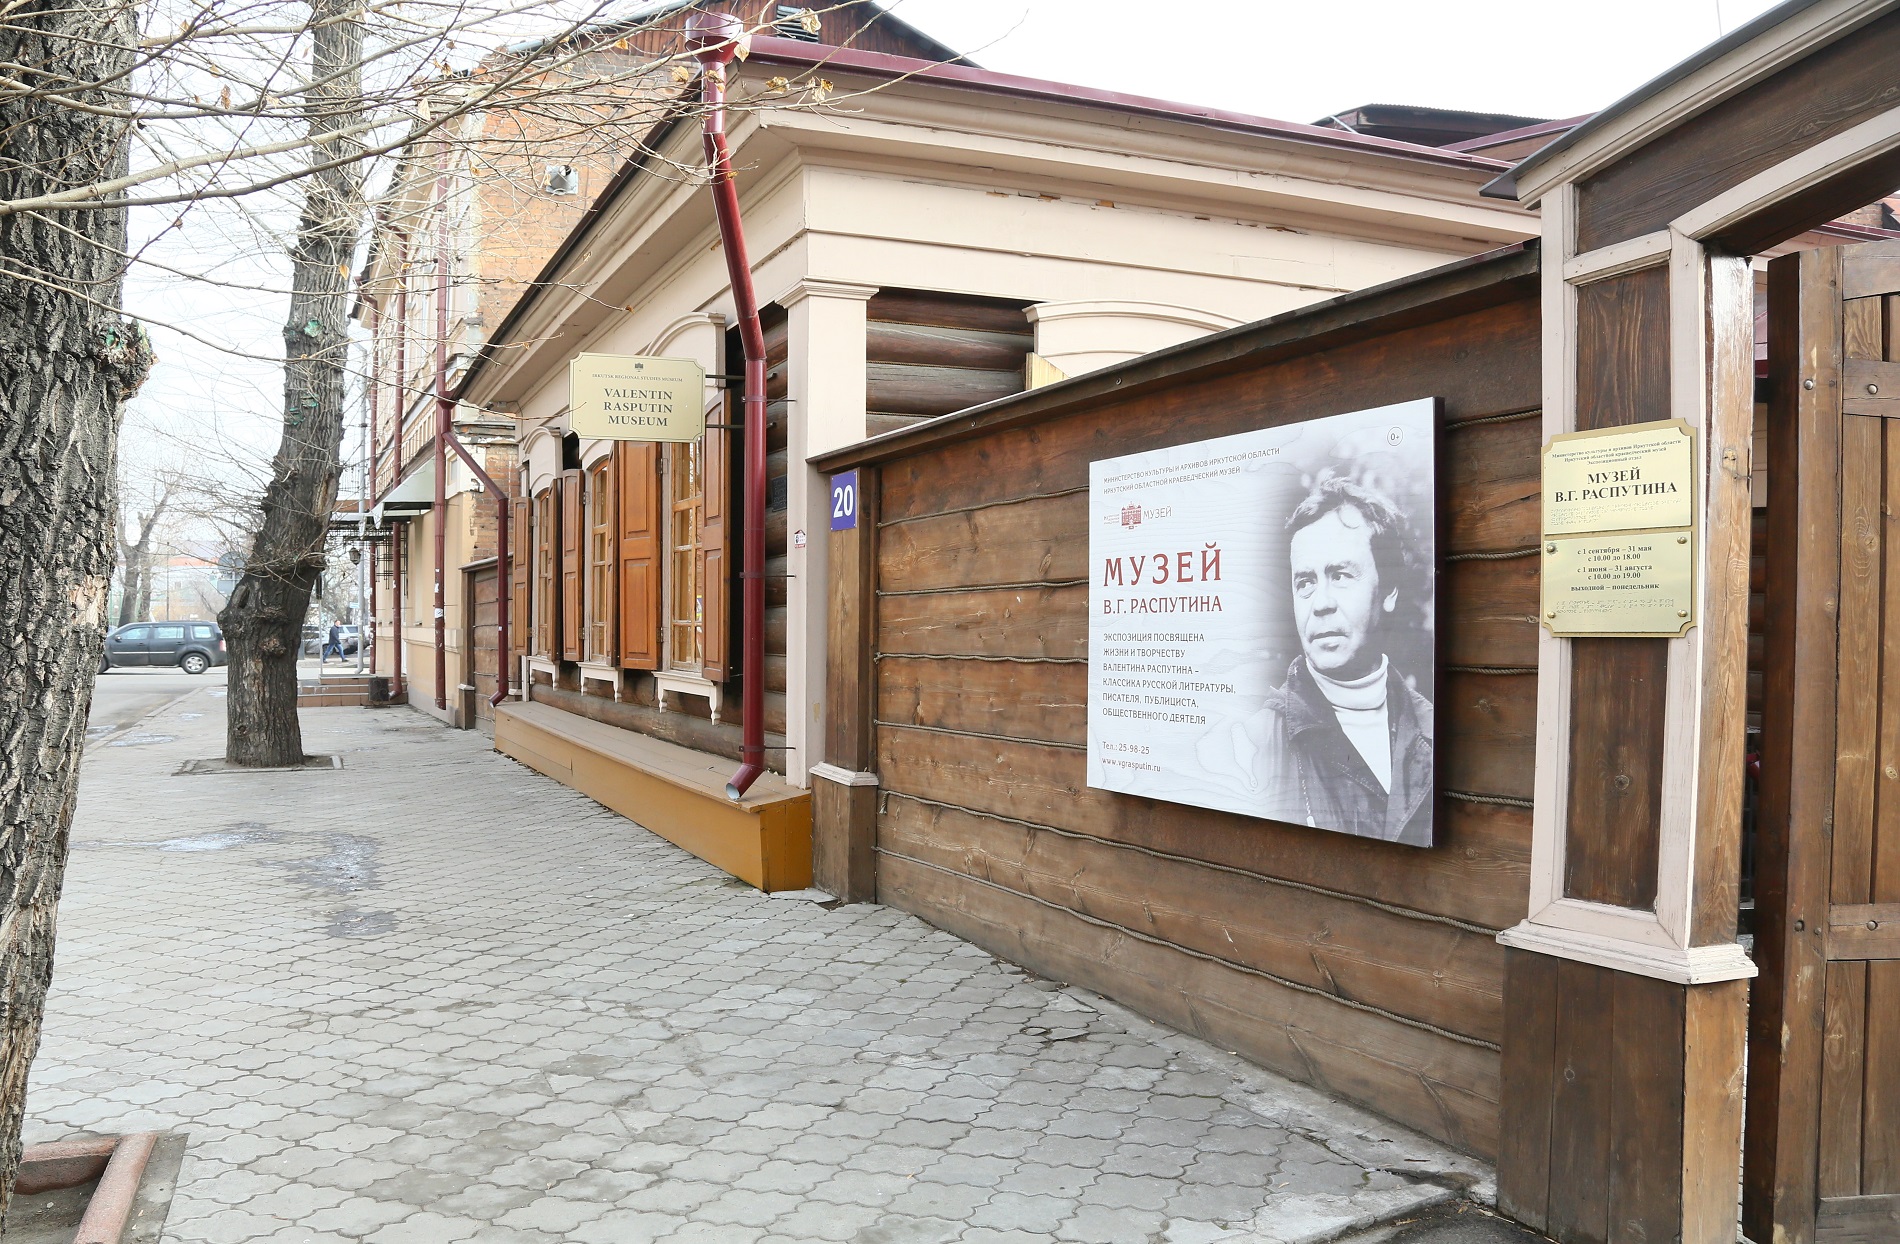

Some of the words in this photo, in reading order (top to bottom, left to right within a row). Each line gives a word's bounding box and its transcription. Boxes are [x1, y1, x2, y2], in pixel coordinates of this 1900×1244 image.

[604, 388, 673, 400] VALENTIN
[603, 401, 673, 413] RASPUTIN
[608, 415, 668, 426] MUSEUM
[1104, 472, 1144, 484] МИНИСТЕРСТВО
[1145, 466, 1174, 477] КУЛЬТУРЫ
[1180, 460, 1208, 471] АРХИВОВ
[1209, 452, 1246, 466] ИРКУТСКОЙ
[1247, 447, 1280, 459] ОБЛАСТИ
[1104, 483, 1134, 495] ИРКУТСКИЙ
[1134, 478, 1168, 490] ОБЛАСТНОЙ
[1169, 469, 1218, 484] КРАЕВЕДЧЕСКИЙ
[1220, 466, 1241, 477] МУЗЕЙ
[1587, 466, 1641, 484] МУЗЕЙ
[1555, 491, 1578, 502] В.Г.
[1582, 482, 1677, 500] РАСПУТИНА
[833, 484, 854, 518] 20
[1143, 505, 1172, 520] МУЗЕЙ
[1588, 547, 1620, 555] сентября
[1593, 554, 1611, 562] 10.00
[1103, 541, 1221, 586] МУЗЕЙ
[1624, 565, 1652, 573] августа
[1570, 584, 1605, 592] выходной
[1612, 583, 1660, 591] понедельник
[1103, 599, 1127, 614] В.Г.
[1130, 595, 1222, 613] РАСПУТИНА
[1103, 633, 1152, 642] ЭКСПОЗИЦИЯ
[1153, 633, 1205, 642] ПОСВЯЩЕНА
[1103, 648, 1129, 657] ЖИЗНИ
[1130, 649, 1136, 657] И
[1136, 649, 1185, 658] ТВОРЧЕСТВУ
[1103, 663, 1145, 673] ВАЛЕНТИНА
[1147, 664, 1193, 674] РАСПУТИНА
[1102, 678, 1141, 688] КЛАССИКА
[1142, 680, 1178, 690] РУССКОЙ
[1178, 682, 1236, 694] ЛИТЕРАТУРЫ,
[1102, 693, 1142, 704] ПИСАТЕЛЯ,
[1144, 695, 1199, 708] ПУБЛИЦИСТА,
[1102, 708, 1168, 721] ОБЩЕСТВЕННОГО
[1169, 713, 1206, 724] ДЕЯТЕЛЯ
[1118, 743, 1150, 754] 25-98-25
[1102, 758, 1161, 772] www.vgrasputin.ru
